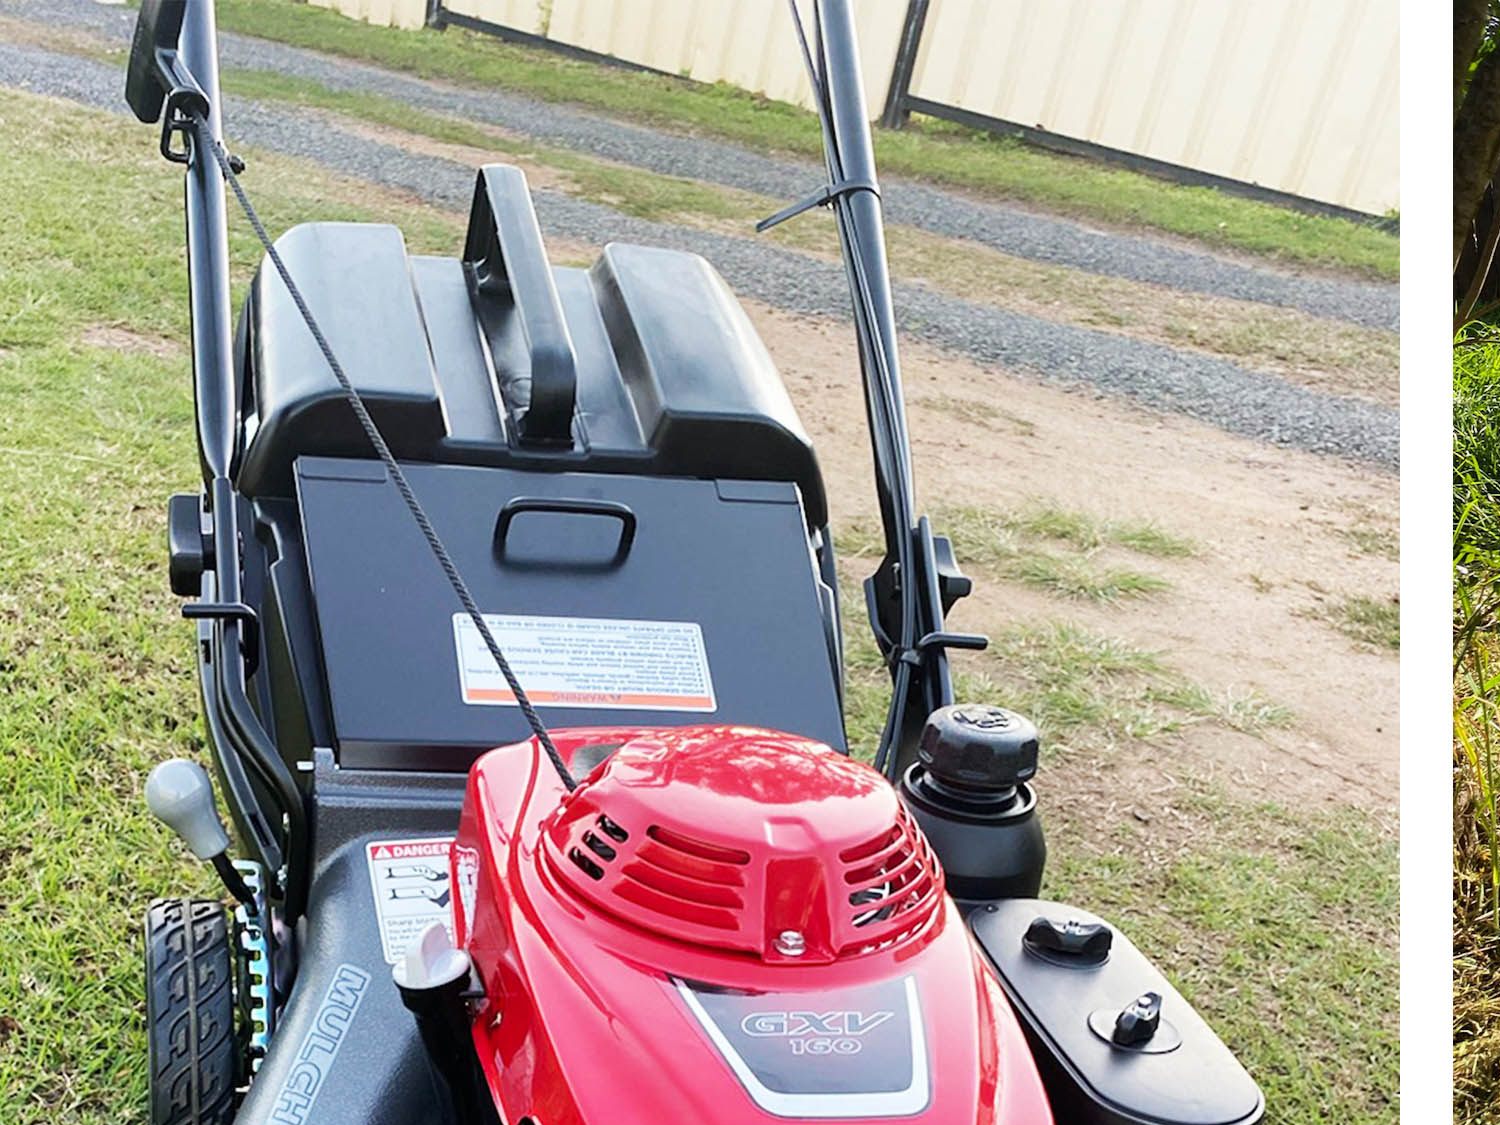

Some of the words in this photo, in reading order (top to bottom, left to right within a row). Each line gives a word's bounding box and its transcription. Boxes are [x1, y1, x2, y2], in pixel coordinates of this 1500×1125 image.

[392, 844, 450, 857] DANGER
[741, 1011, 894, 1036] GXV
[789, 1038, 863, 1055] 160
